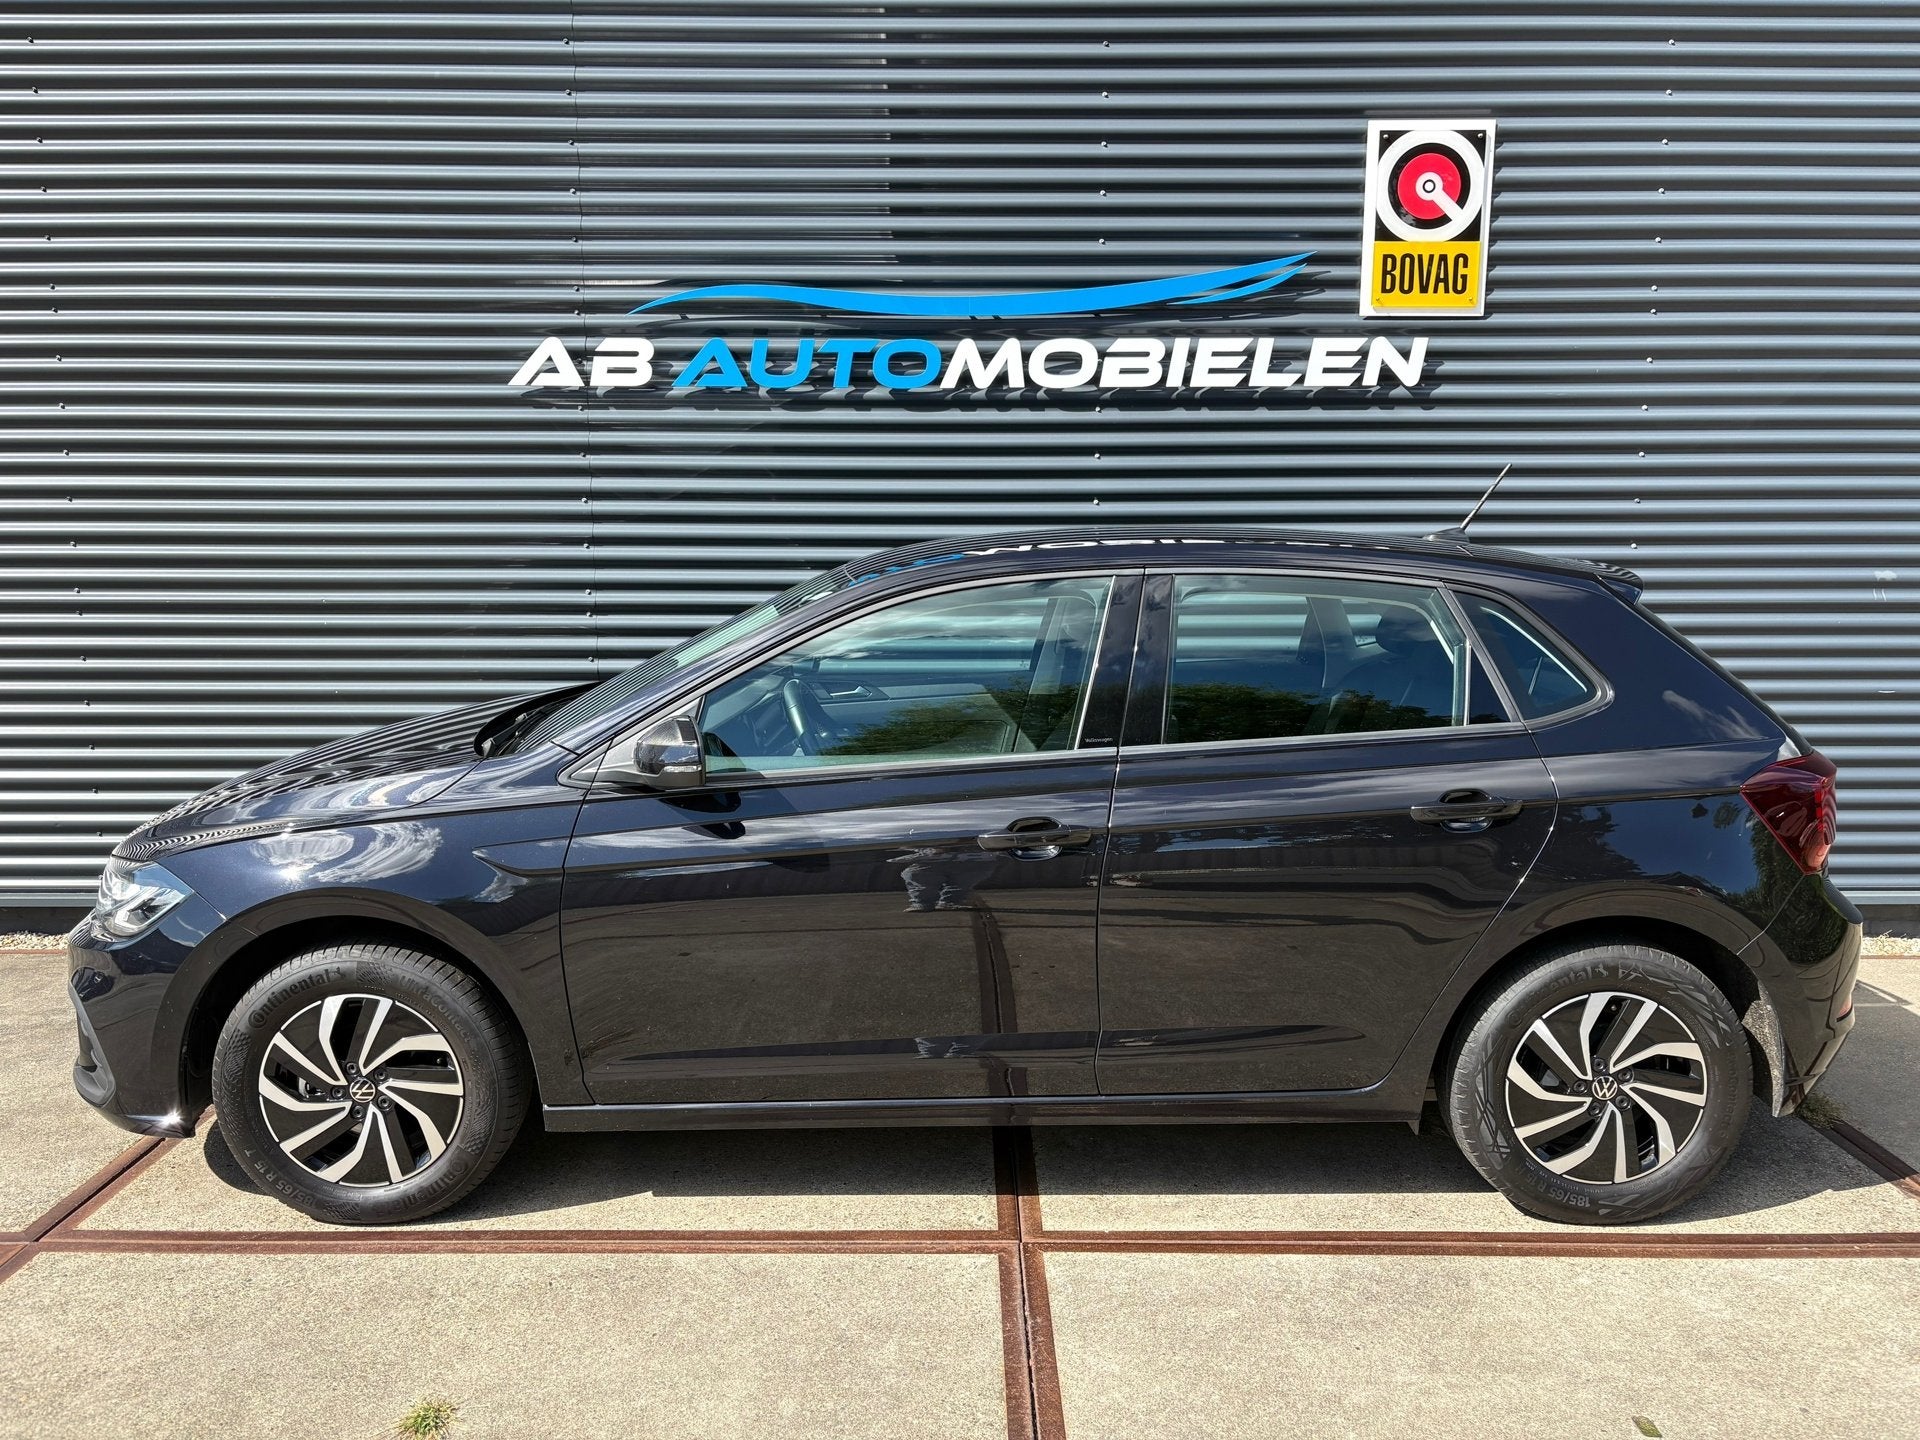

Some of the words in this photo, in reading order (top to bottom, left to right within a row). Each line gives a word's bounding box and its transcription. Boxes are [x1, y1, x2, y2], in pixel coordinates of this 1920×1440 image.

[1380, 252, 1469, 295] BOVAG
[507, 336, 655, 387] AB
[671, 335, 1429, 389] AUTOMOBIELEN
[248, 968, 332, 1029] Continental
